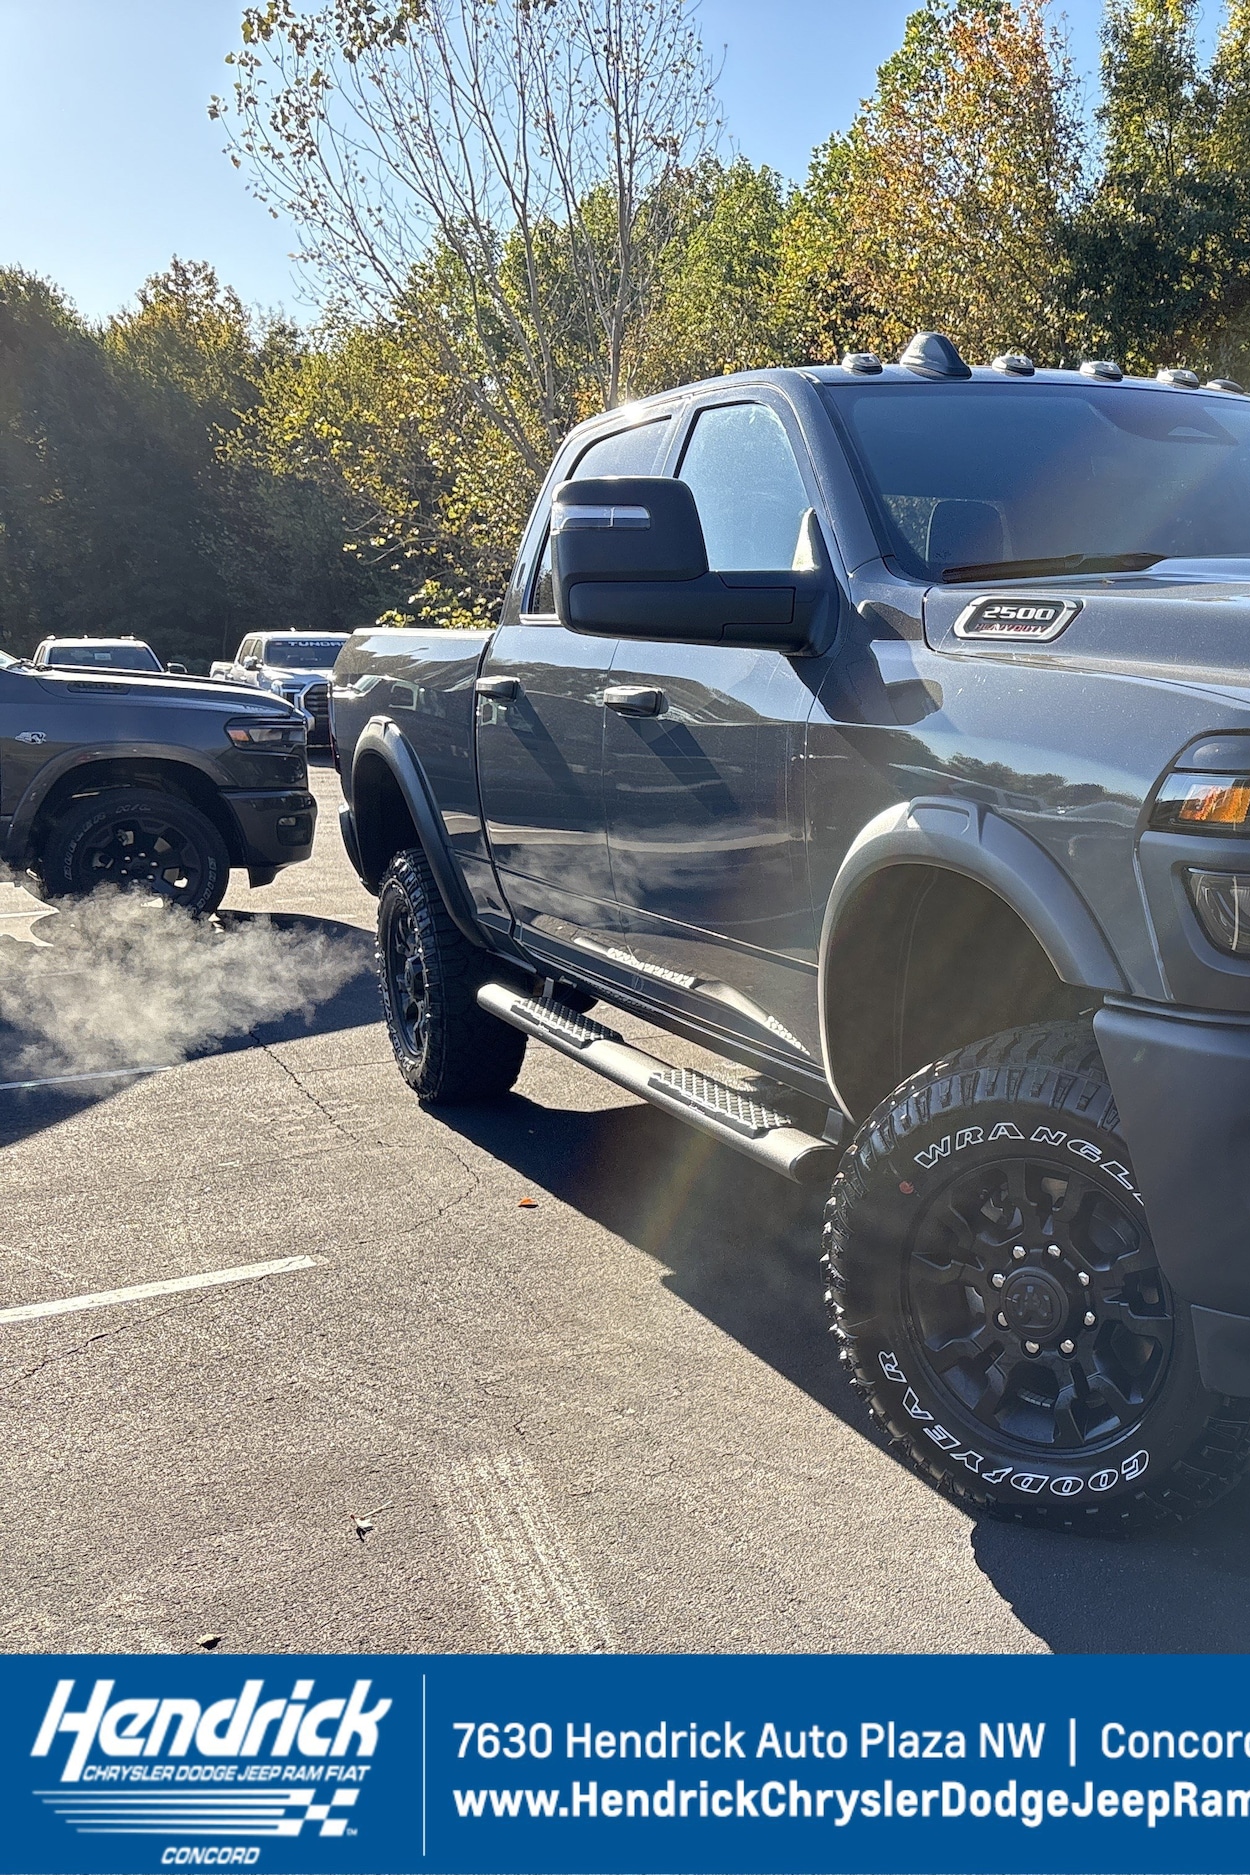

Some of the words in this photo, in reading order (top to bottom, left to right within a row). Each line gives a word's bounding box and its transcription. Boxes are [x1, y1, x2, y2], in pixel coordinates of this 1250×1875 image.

[983, 606, 1056, 621] 2500
[1012, 624, 1047, 633] DUTY
[914, 1122, 1145, 1206] WRANGL
[878, 1350, 1150, 1496] GOODYEAR
